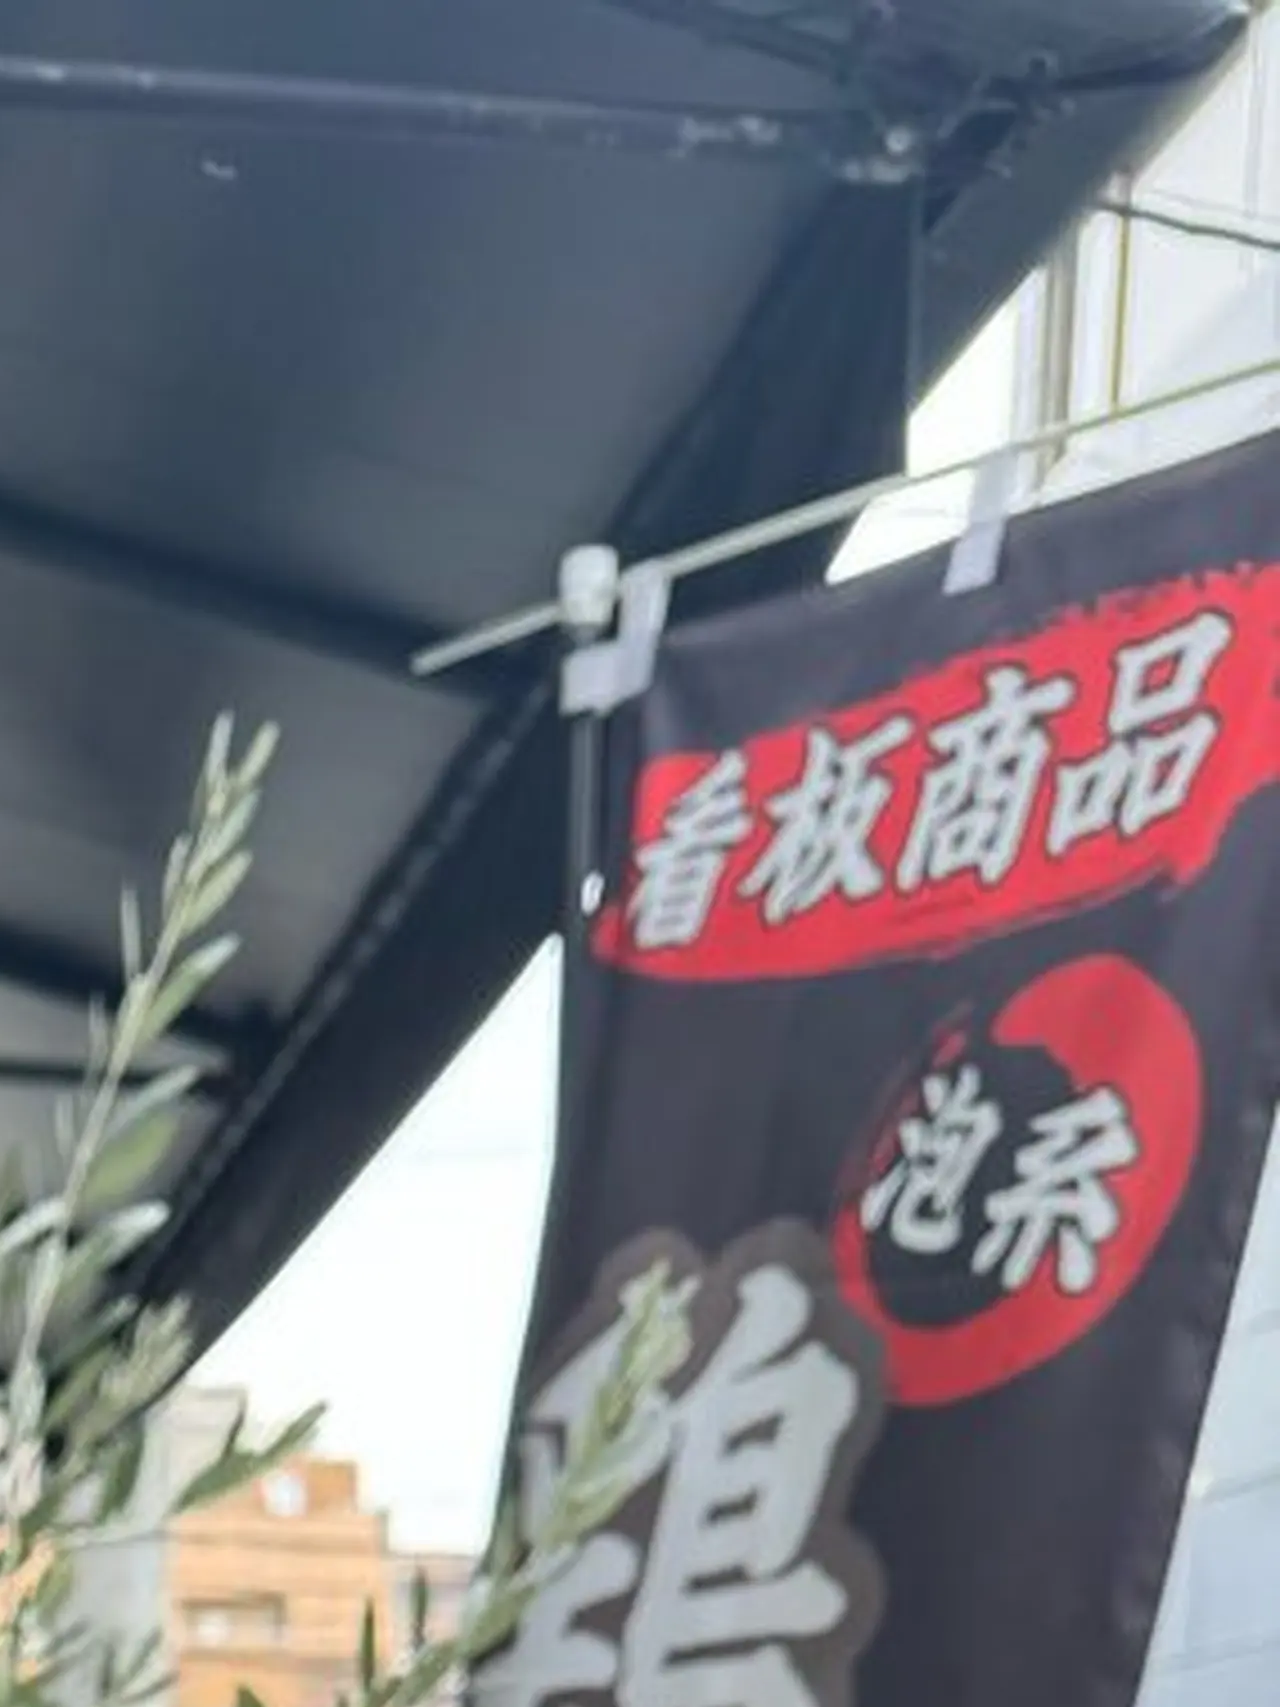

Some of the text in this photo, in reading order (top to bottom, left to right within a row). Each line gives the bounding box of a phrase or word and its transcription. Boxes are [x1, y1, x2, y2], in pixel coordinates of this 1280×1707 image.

[628, 610, 1234, 950] 看板商品
[859, 1063, 1140, 1295] 泡系
